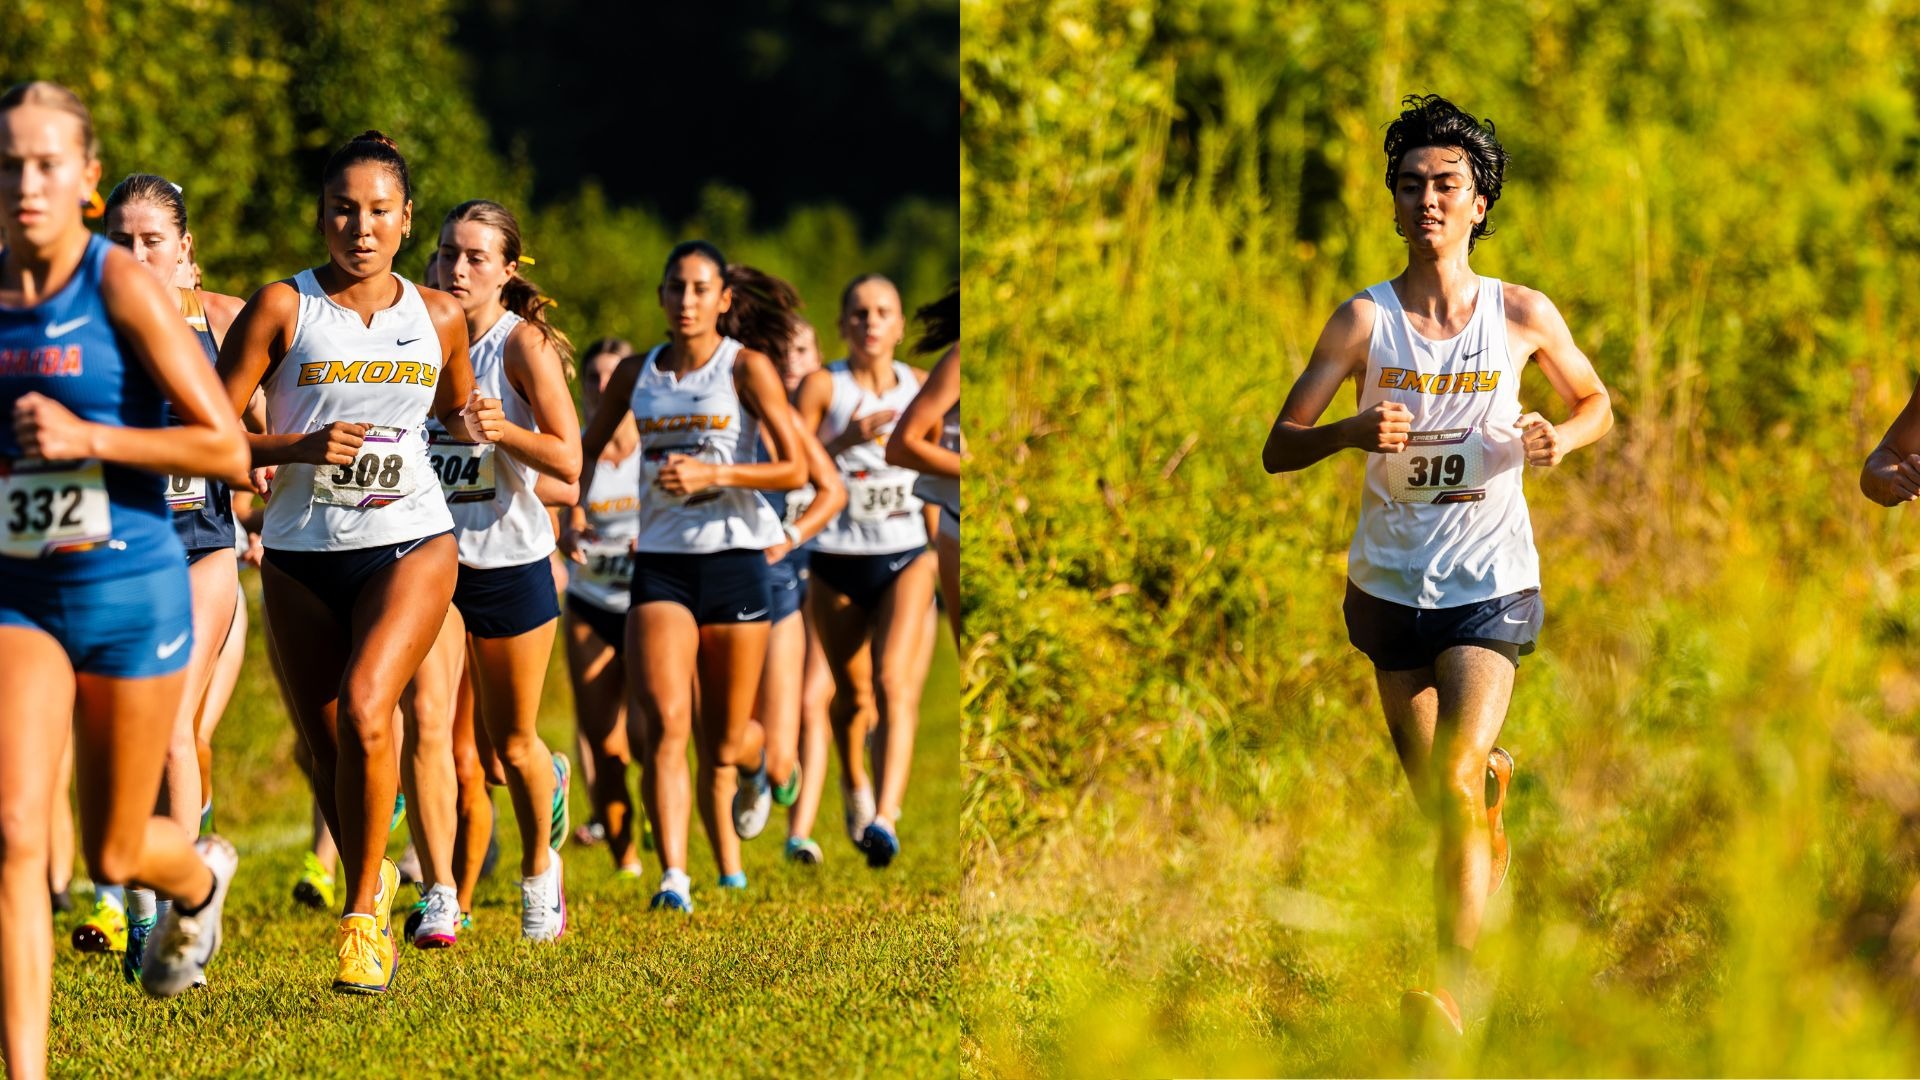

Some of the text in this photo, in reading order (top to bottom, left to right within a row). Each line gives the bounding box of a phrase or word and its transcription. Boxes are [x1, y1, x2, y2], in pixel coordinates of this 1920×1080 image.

[297, 360, 438, 388] EMORY
[1378, 367, 1502, 395] EMORY
[331, 453, 404, 489] 308
[430, 454, 482, 486] 304
[1407, 453, 1466, 487] 319
[7, 485, 83, 534] 332
[863, 486, 906, 511] 305
